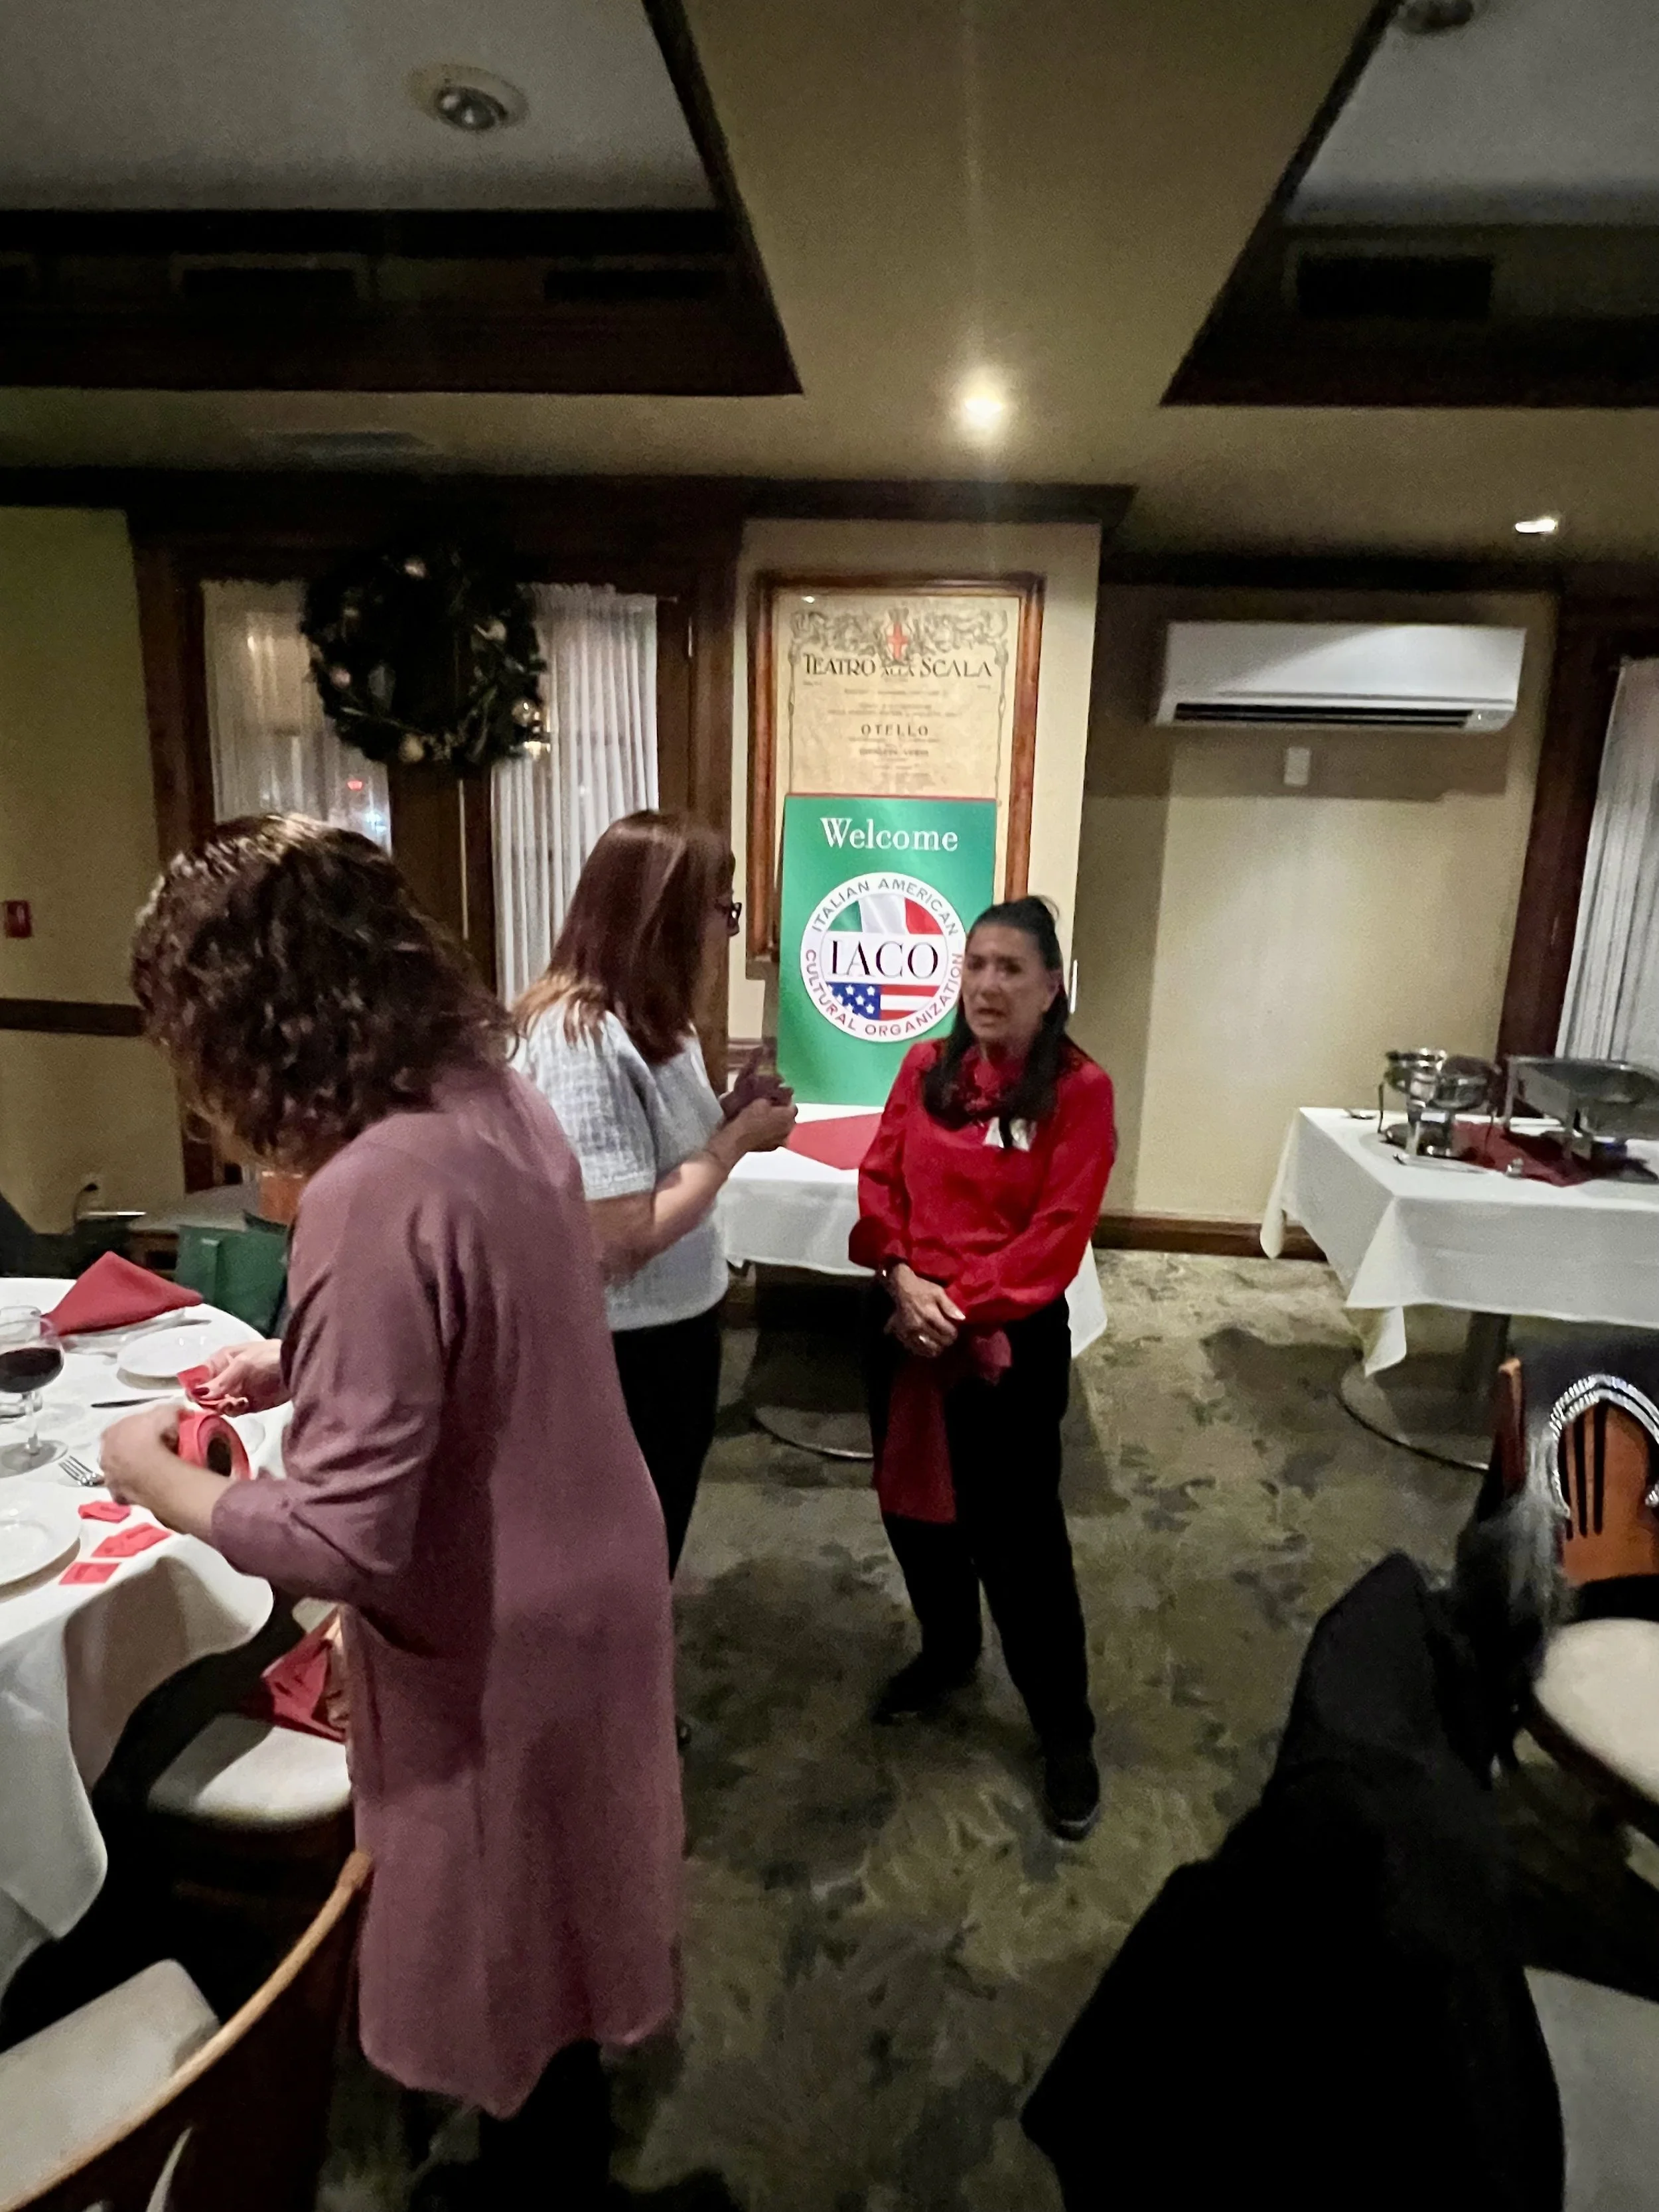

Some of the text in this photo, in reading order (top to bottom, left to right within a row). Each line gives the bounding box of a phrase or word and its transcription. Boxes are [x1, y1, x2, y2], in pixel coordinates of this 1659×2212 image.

[804, 654, 876, 676] TEATRO
[920, 658, 993, 678] SCALA
[861, 724, 929, 737] OTELLO
[821, 818, 958, 851] Welcome
[812, 878, 959, 936] ITALIAN AMERICAN
[829, 940, 938, 980] IACO
[805, 949, 964, 1037] CULTURAL ORGANIZATION
